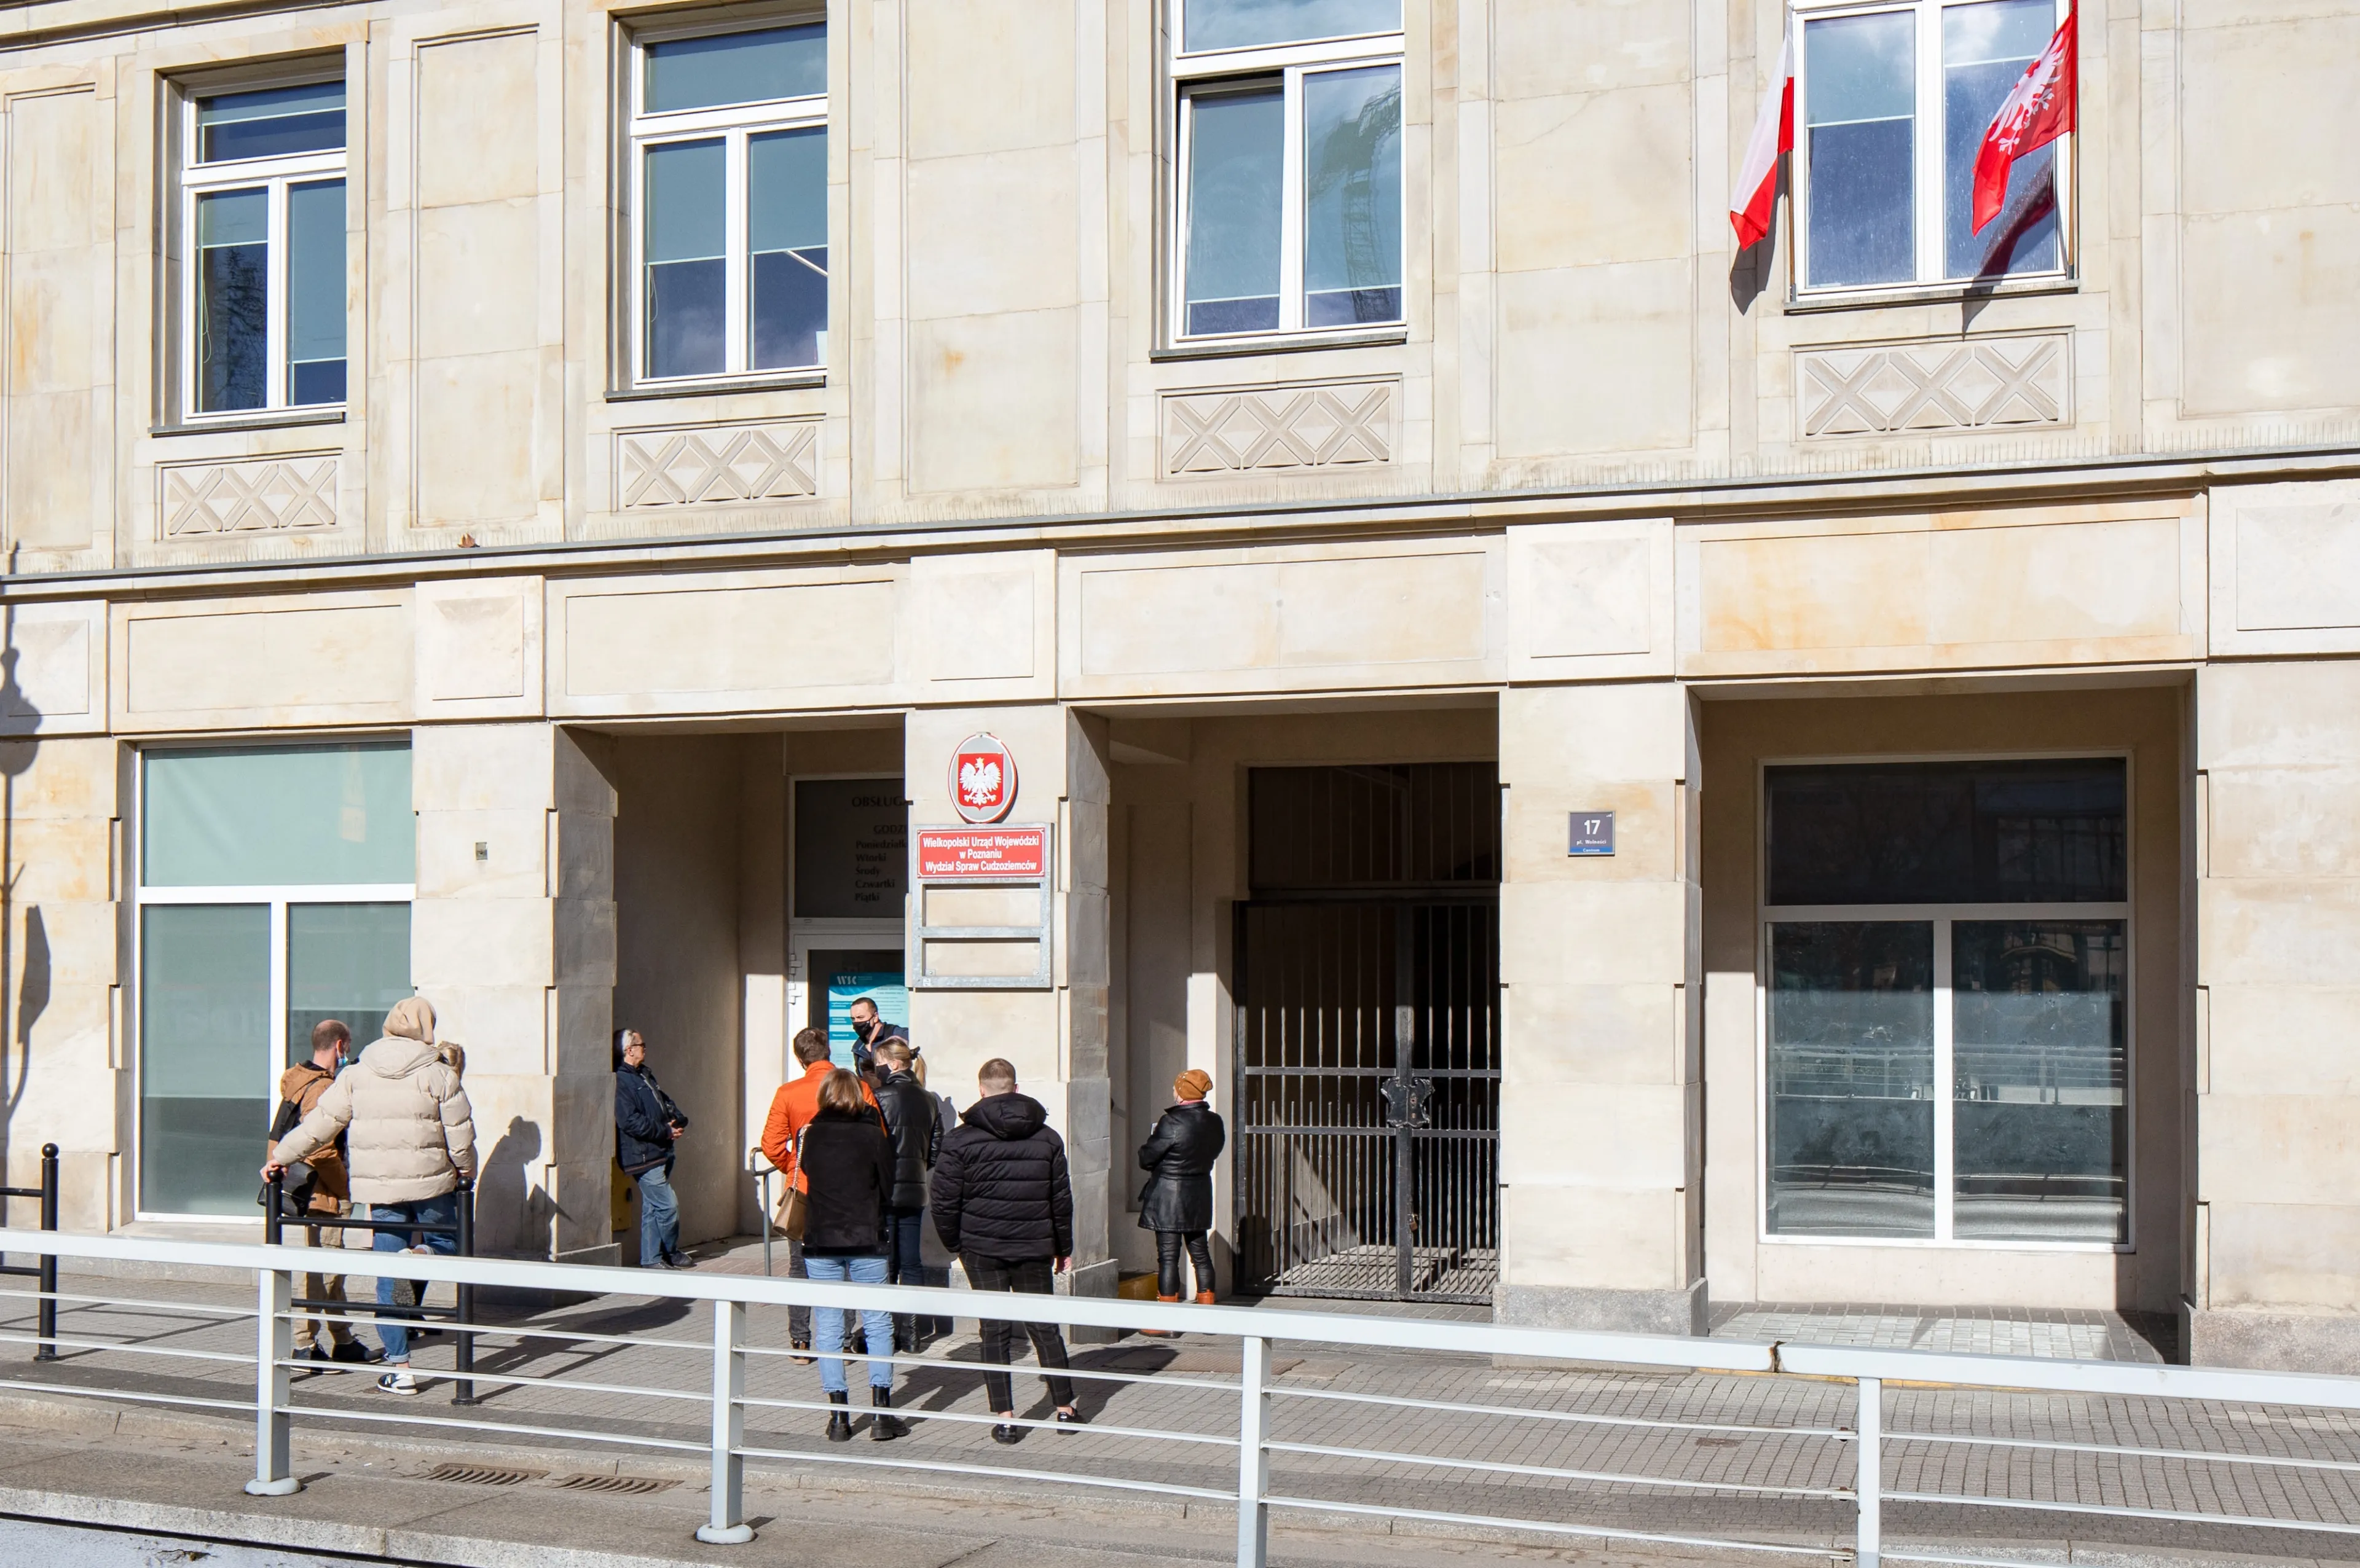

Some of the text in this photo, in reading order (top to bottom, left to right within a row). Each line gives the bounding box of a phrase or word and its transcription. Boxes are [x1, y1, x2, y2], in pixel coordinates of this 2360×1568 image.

[1584, 820, 1600, 834] 17
[922, 836, 1039, 849] Wielkopolski Urząd Wojewódzki
[856, 853, 886, 862] Wtorki
[967, 849, 1002, 859] Poznaniu
[855, 864, 880, 877] Środy
[926, 860, 1037, 874] Wydział Spraw Cudzoziemców
[855, 879, 895, 888] Czwartki
[854, 893, 879, 903] Piątki
